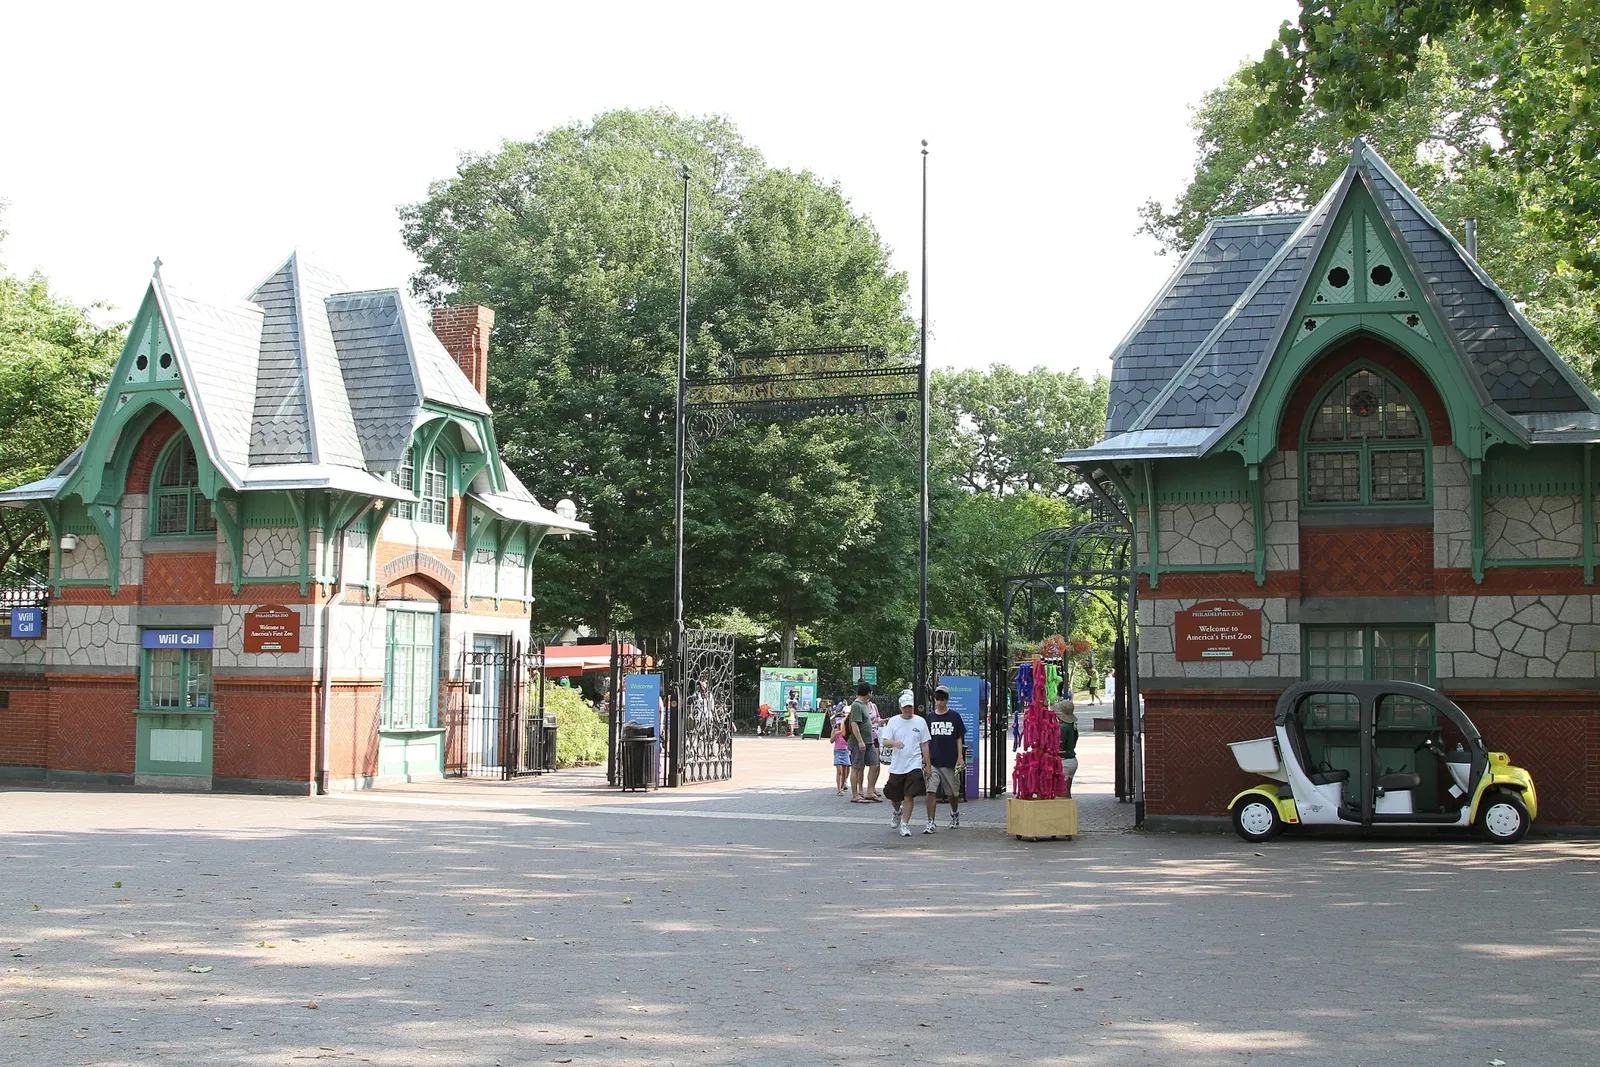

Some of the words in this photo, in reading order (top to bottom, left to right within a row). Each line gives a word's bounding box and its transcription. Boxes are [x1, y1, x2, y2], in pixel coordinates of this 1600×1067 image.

[741, 352, 861, 376] GARDEN
[688, 381, 811, 401] ZOOLOGICAL
[18, 612, 34, 621] Will
[19, 623, 34, 632] Call
[158, 633, 178, 644] Will
[180, 633, 200, 644] Call
[1186, 633, 1219, 641] America's
[1221, 632, 1236, 640] First
[1237, 632, 1252, 640] Zoo
[931, 721, 954, 729] STAR
